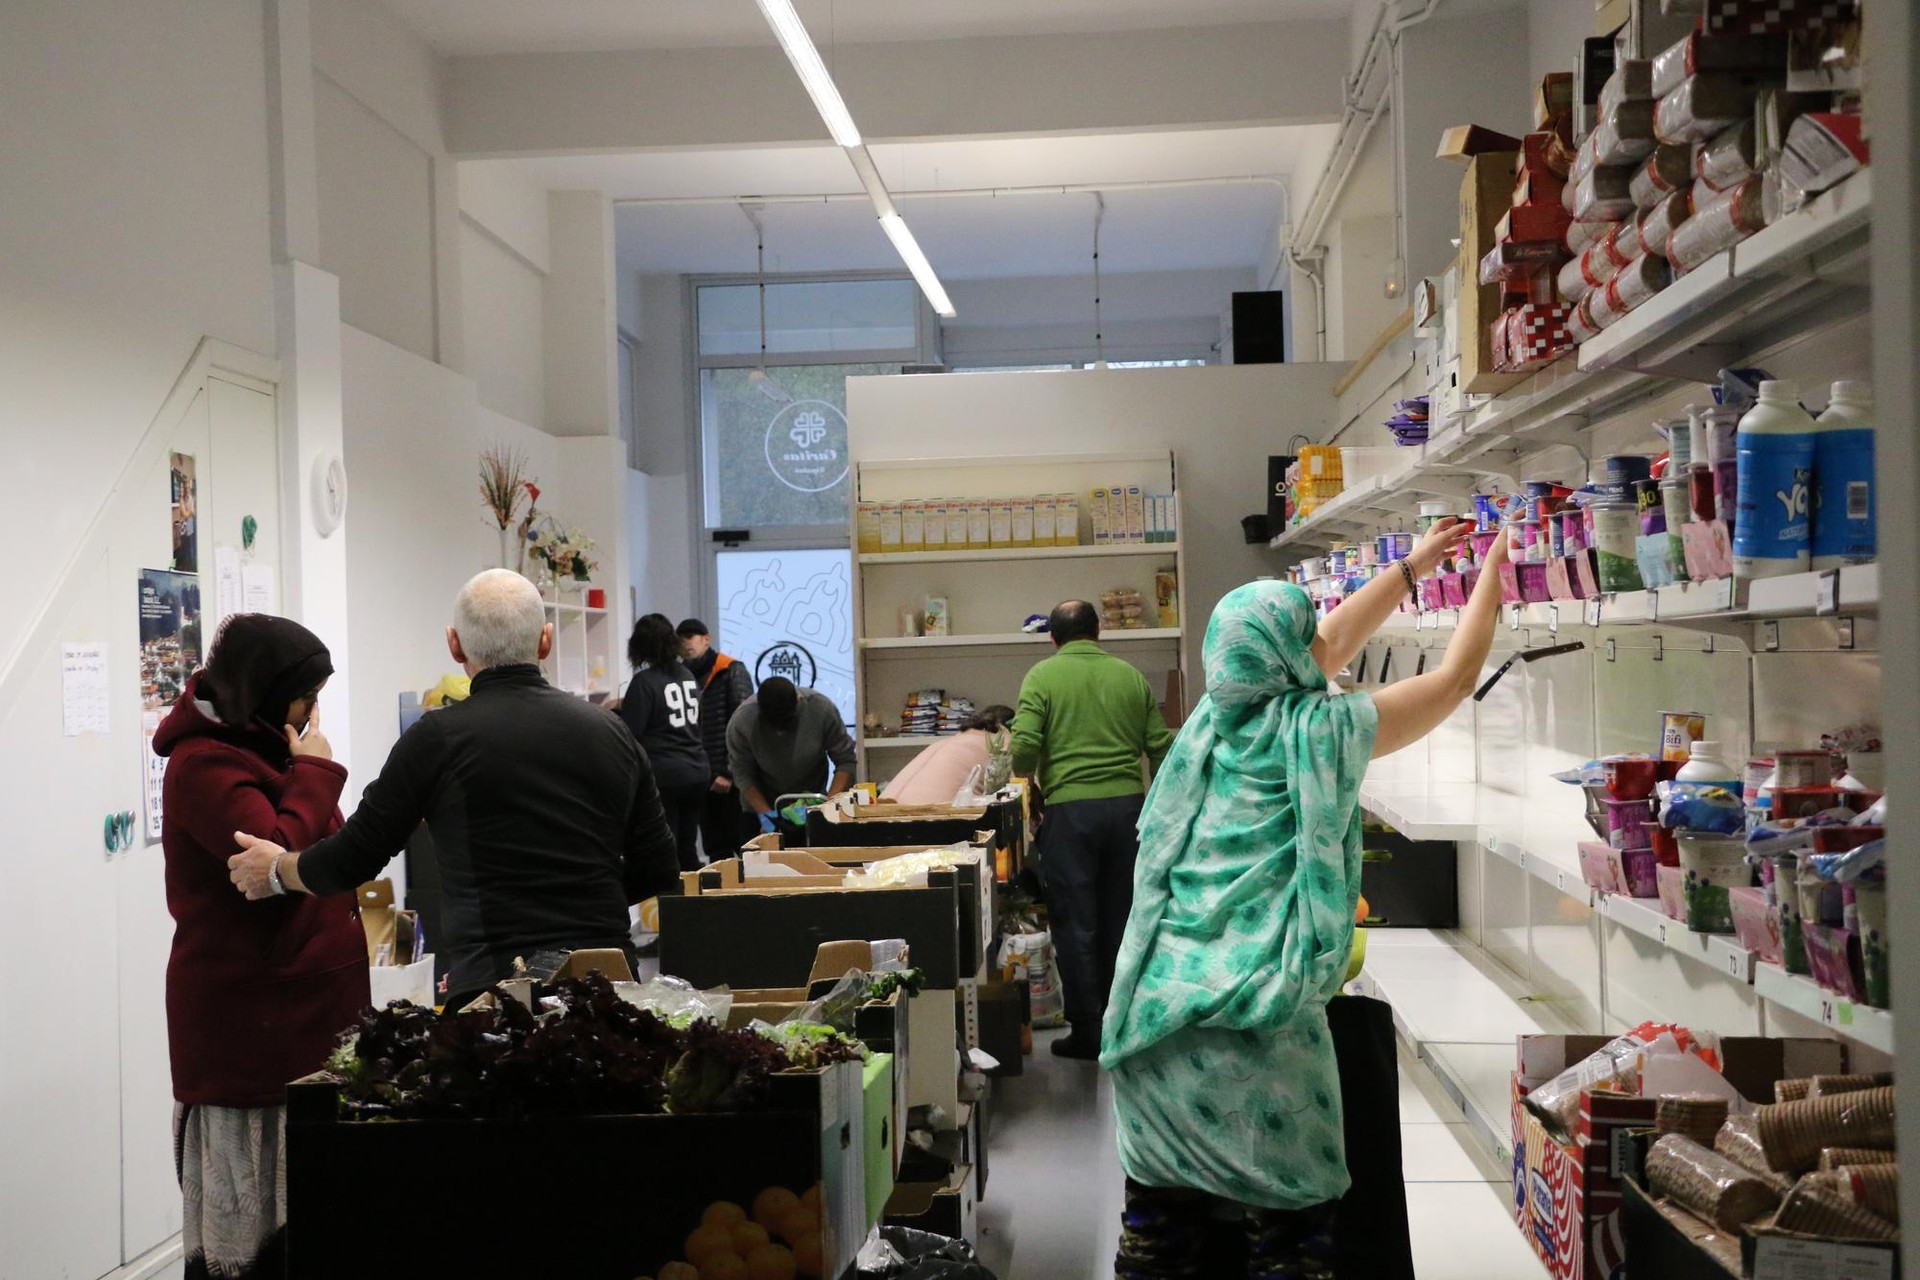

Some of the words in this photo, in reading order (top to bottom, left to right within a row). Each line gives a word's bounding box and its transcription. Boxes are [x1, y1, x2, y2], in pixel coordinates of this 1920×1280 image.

[664, 680, 699, 728] 95
[1659, 923, 1666, 943] 72
[1729, 955, 1737, 975] 73
[1821, 1000, 1832, 1025] 74
